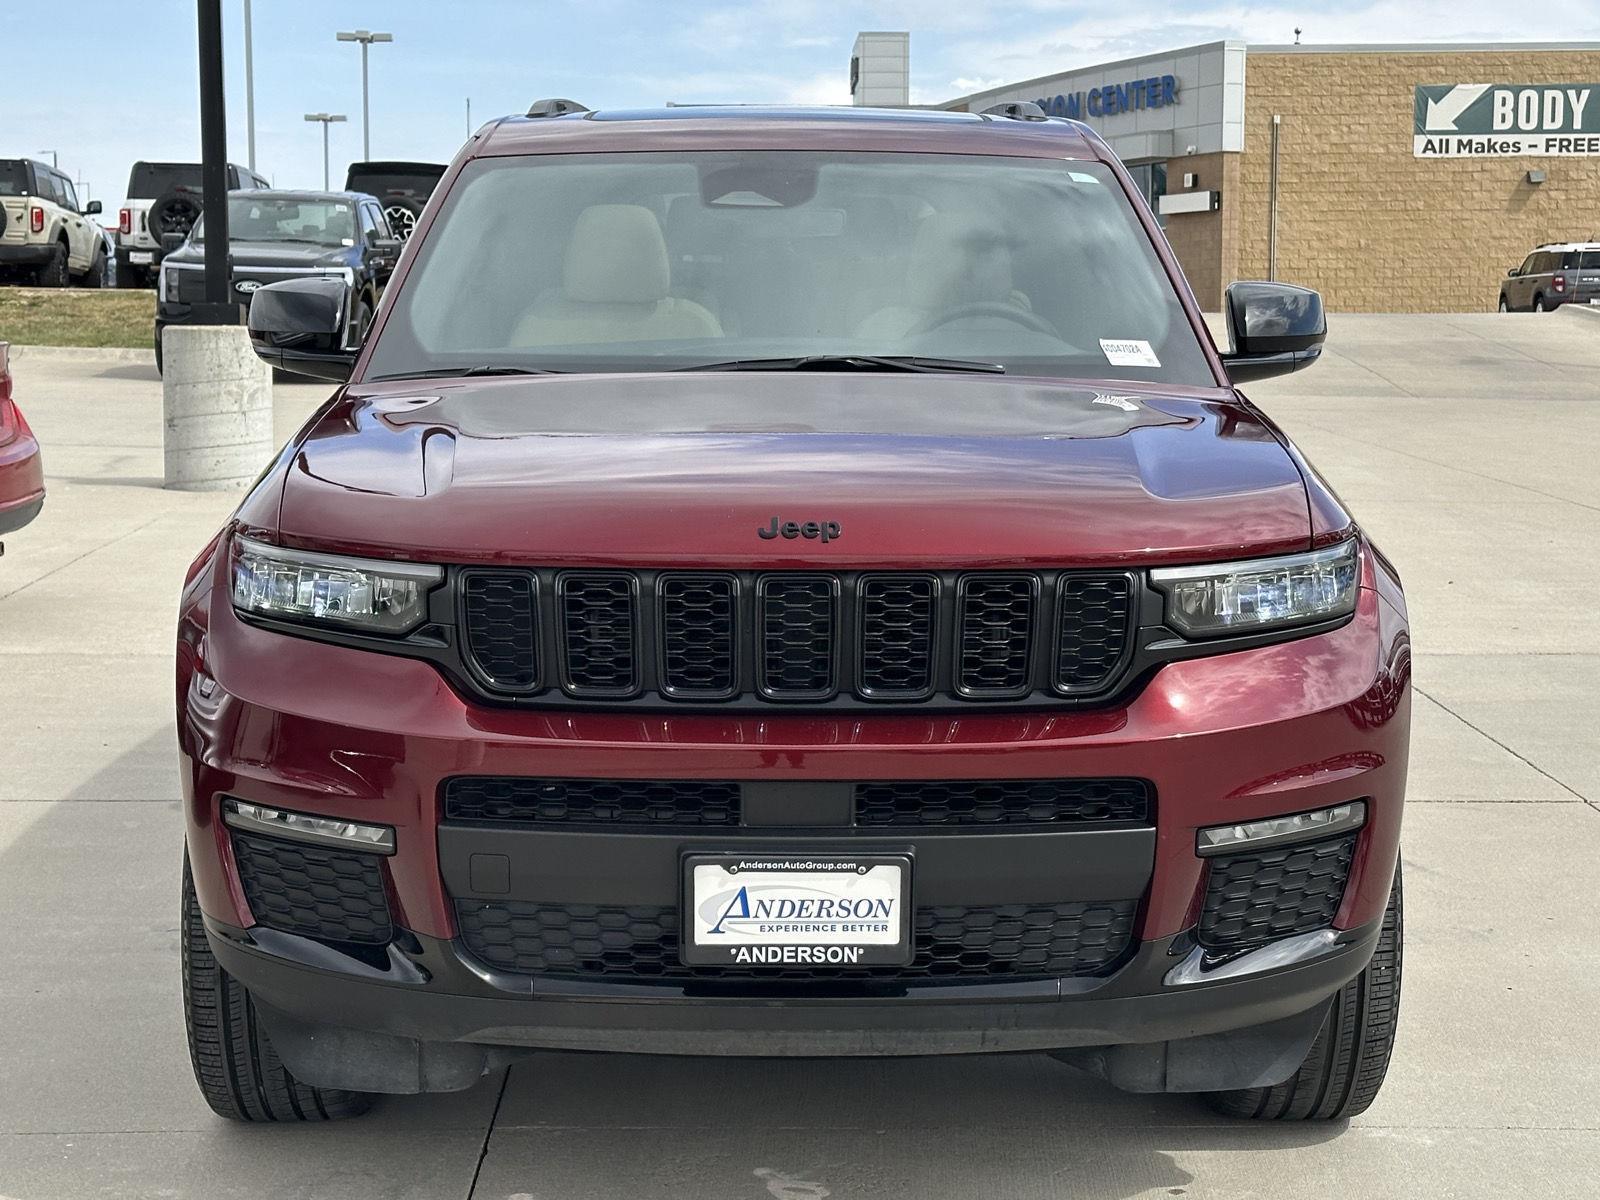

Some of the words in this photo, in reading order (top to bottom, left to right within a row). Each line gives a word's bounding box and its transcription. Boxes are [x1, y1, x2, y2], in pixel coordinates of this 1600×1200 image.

[1087, 75, 1176, 118] CENTER
[1493, 89, 1591, 130] BODY
[1422, 138, 1450, 154] All
[1457, 137, 1522, 154] Makes
[1545, 137, 1600, 153] FREE
[758, 516, 841, 543] Jeep
[739, 861, 857, 872] AndersonAutoGroup.com
[760, 924, 837, 933] EXPERIENCE
[842, 924, 889, 933] BETTER
[735, 946, 858, 963] ANDERSON
